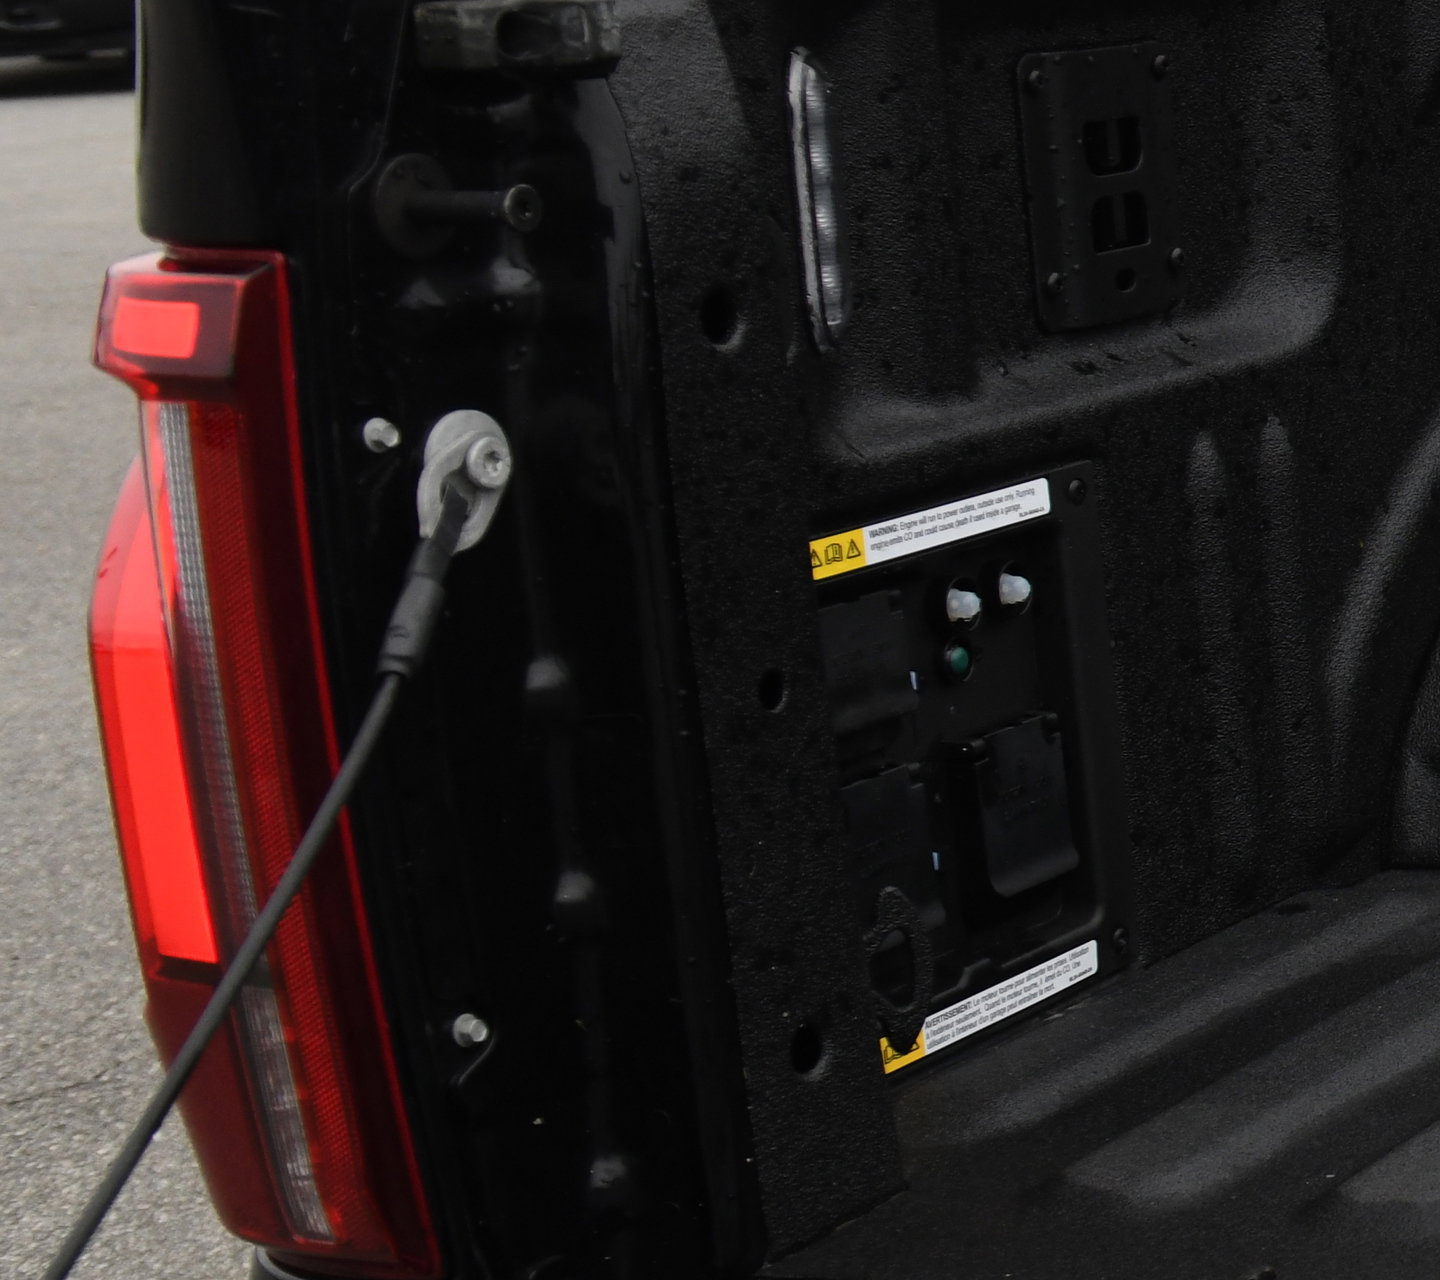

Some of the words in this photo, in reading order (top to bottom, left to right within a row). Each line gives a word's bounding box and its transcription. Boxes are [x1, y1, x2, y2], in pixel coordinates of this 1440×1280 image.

[868, 524, 899, 538] WARNING:
[899, 520, 918, 531] Engine
[918, 516, 927, 524] will
[943, 509, 958, 519] power
[1015, 487, 1035, 498] Running
[870, 541, 888, 551] engine
[903, 531, 913, 541] CO
[914, 530, 924, 538] and
[924, 525, 938, 535] could
[973, 512, 985, 521] used
[972, 998, 980, 1006] Le
[981, 990, 998, 1002] moteur
[1014, 977, 1025, 988] pour
[983, 999, 1001, 1012] Quand
[1006, 989, 1023, 1001] moteur
[990, 1006, 1007, 1021] garage
[1007, 1001, 1018, 1013] peut
